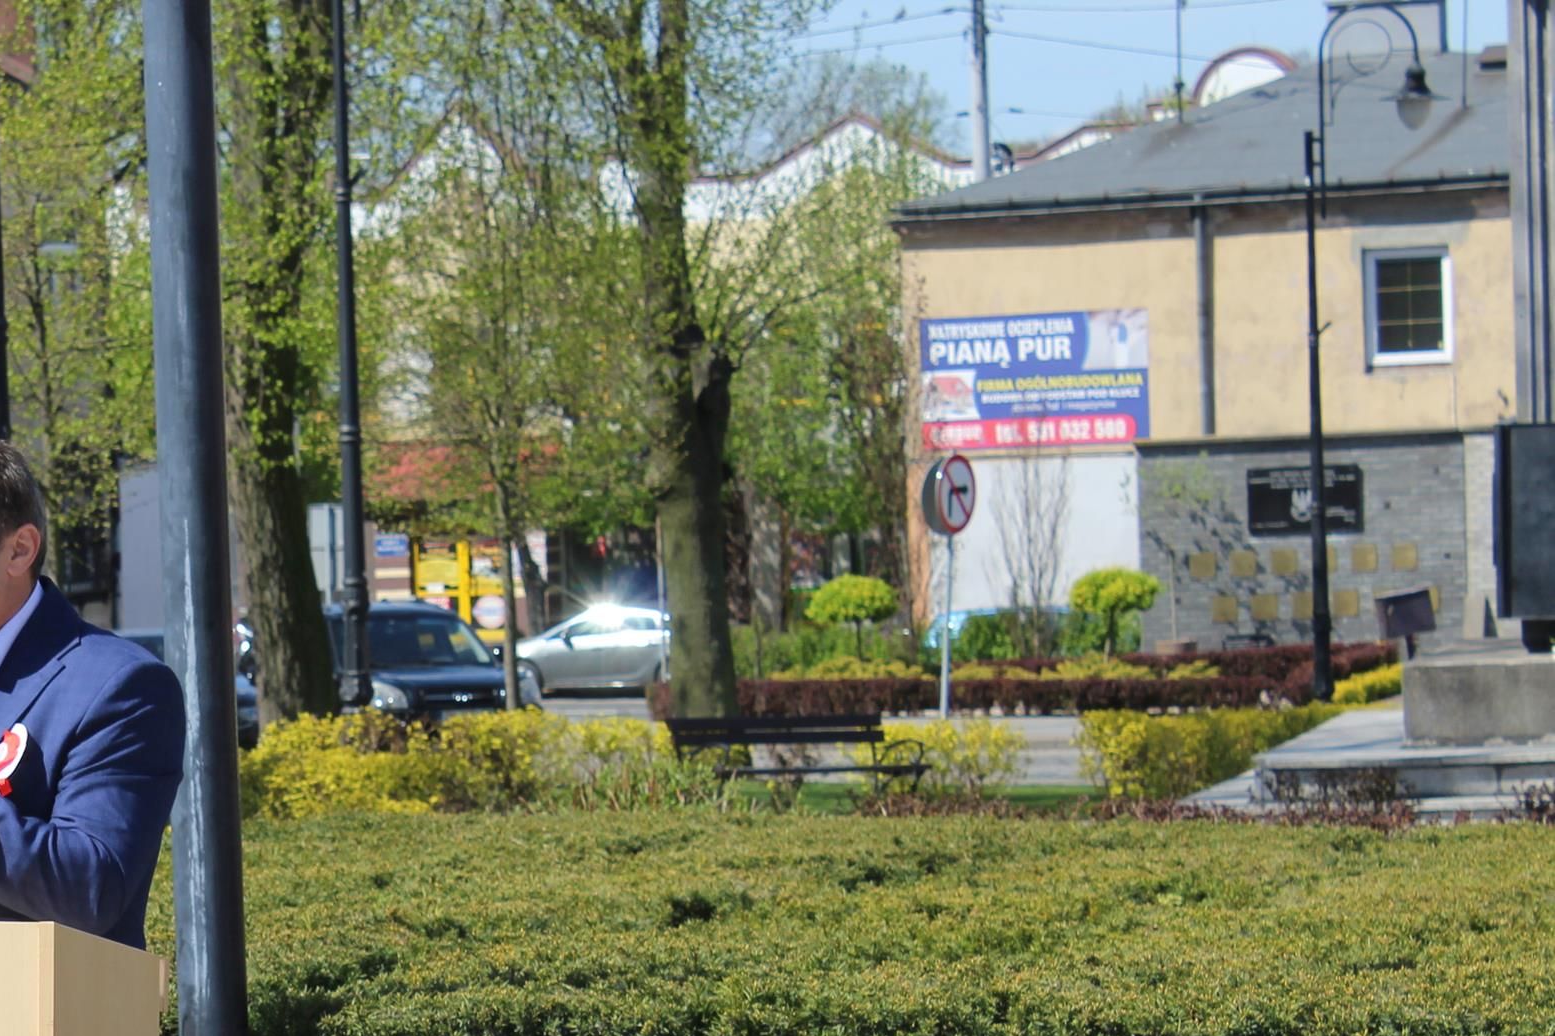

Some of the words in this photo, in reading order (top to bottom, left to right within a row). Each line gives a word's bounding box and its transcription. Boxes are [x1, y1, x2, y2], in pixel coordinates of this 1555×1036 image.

[928, 321, 1006, 340] NATRYSKOWE
[1007, 317, 1074, 337] OCIEPLENIA
[929, 339, 1011, 368] PIANĄ
[1018, 335, 1071, 361] PUR
[977, 378, 1014, 392] FIRMA
[1016, 372, 1143, 390] OGÓLNOBUDOWLANA
